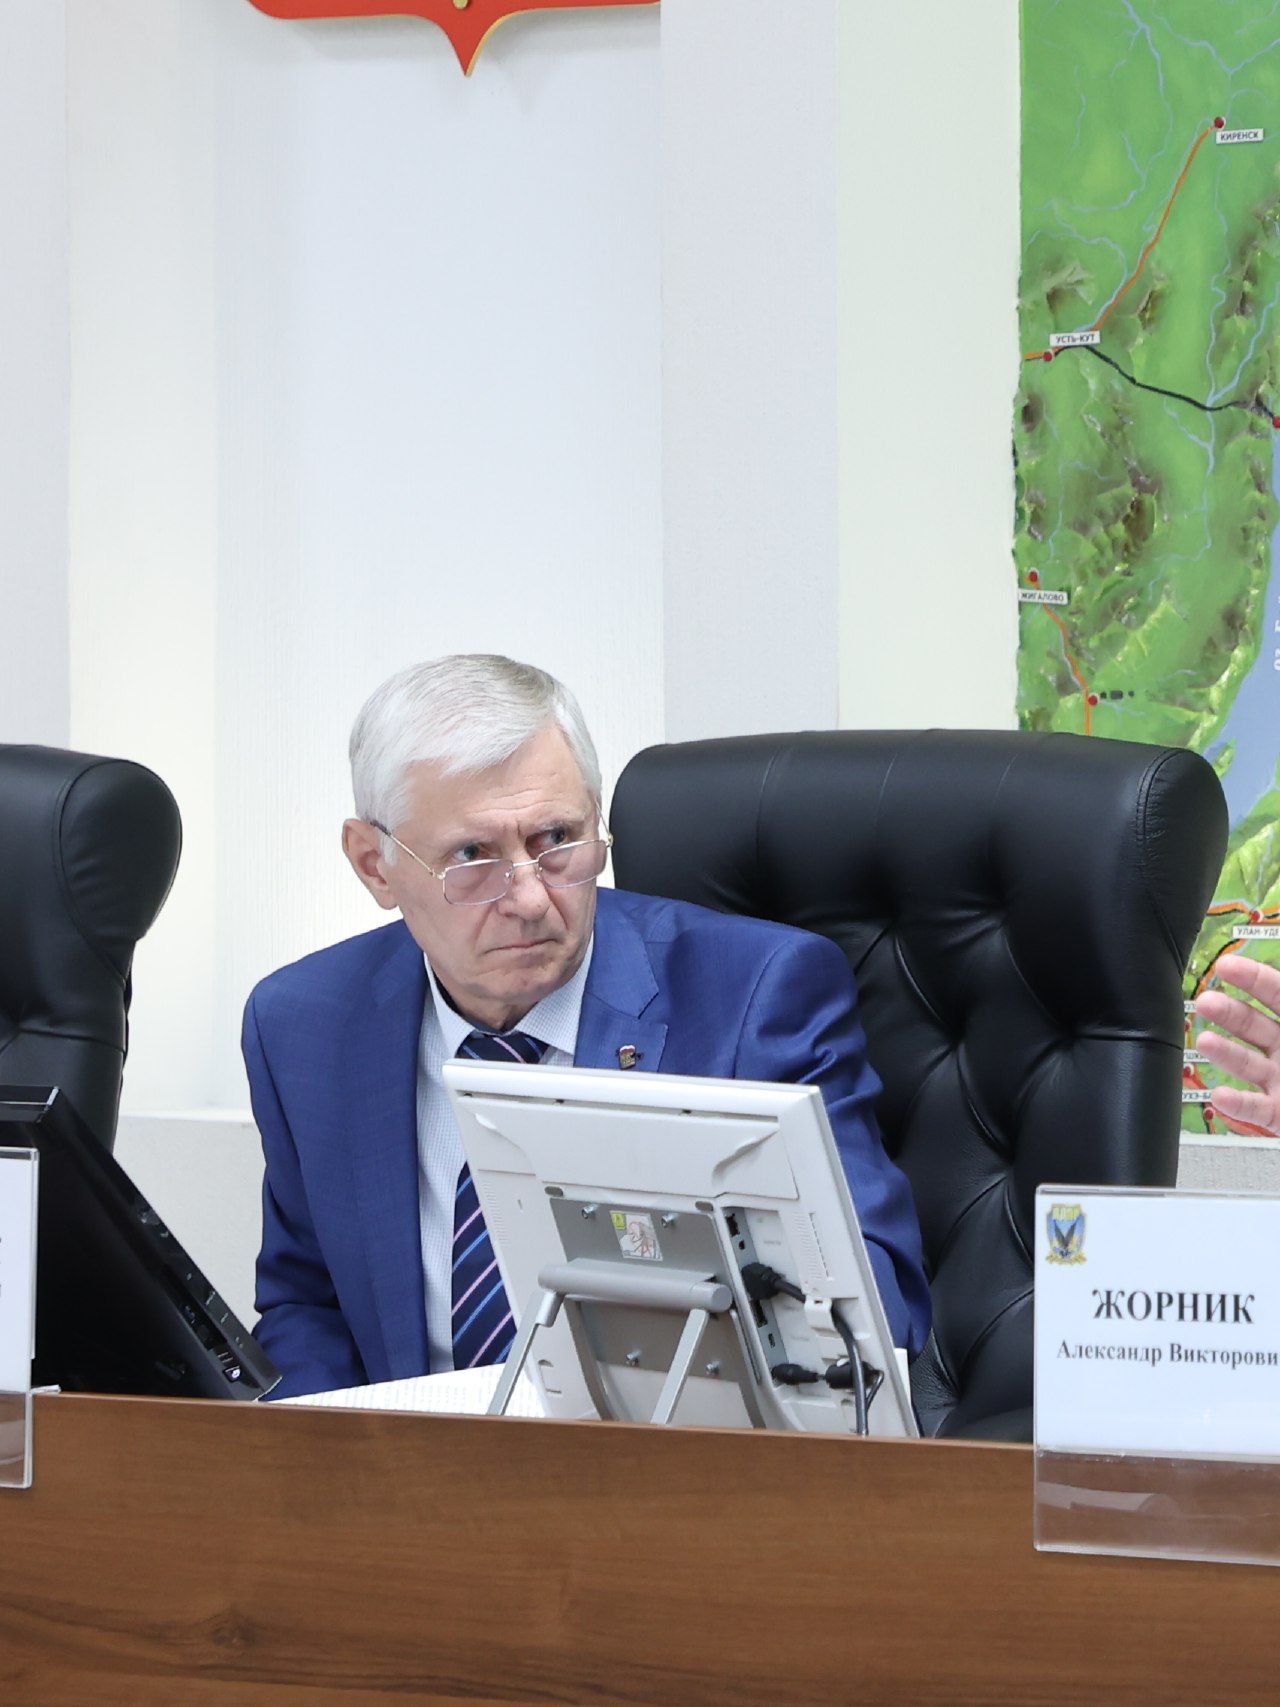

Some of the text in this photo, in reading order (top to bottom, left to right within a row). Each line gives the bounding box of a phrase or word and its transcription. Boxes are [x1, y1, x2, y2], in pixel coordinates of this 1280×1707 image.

[1220, 131, 1259, 141] КИРЕНСК
[1056, 334, 1095, 344] УСТЬ-КУТ
[1092, 1289, 1255, 1324] ЖОРНИК
[1056, 1339, 1162, 1367] Александр
